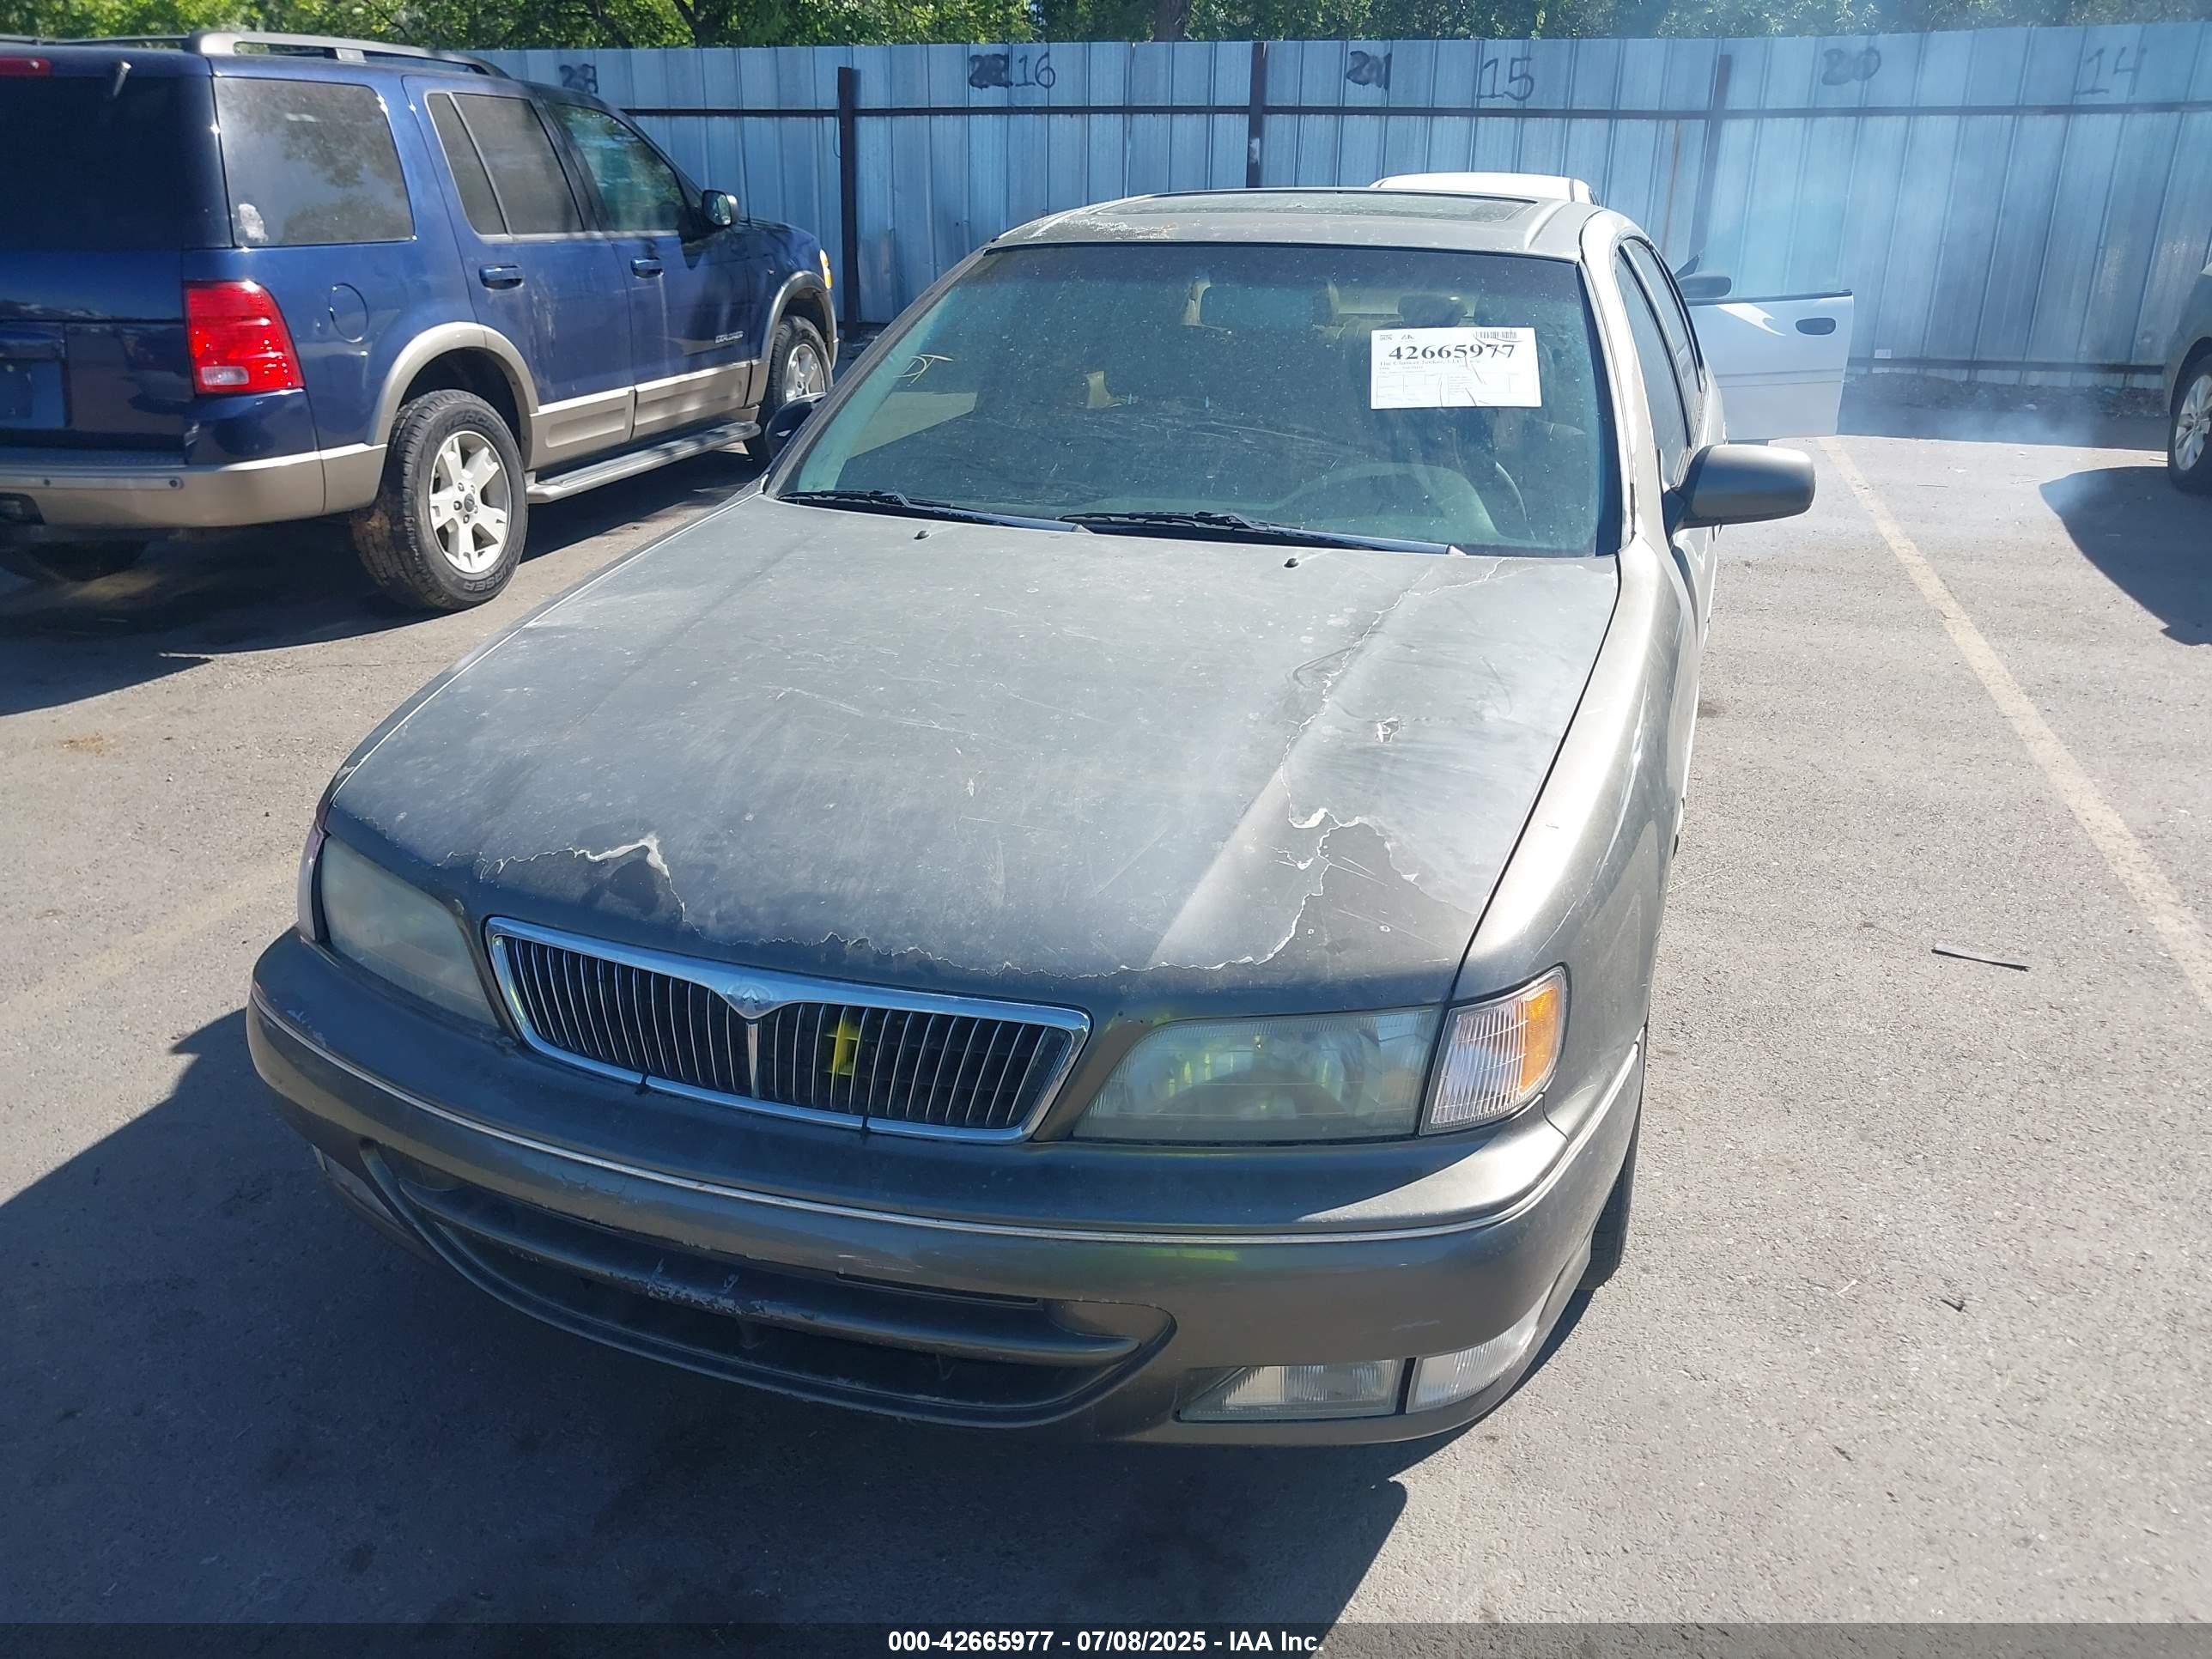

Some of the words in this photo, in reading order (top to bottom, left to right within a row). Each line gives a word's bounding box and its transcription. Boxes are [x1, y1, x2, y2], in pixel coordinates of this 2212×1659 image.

[1015, 52, 1056, 88] 16
[1476, 58, 1534, 100] 15
[2074, 46, 2148, 96] 14
[1389, 343, 1515, 360] 42665977
